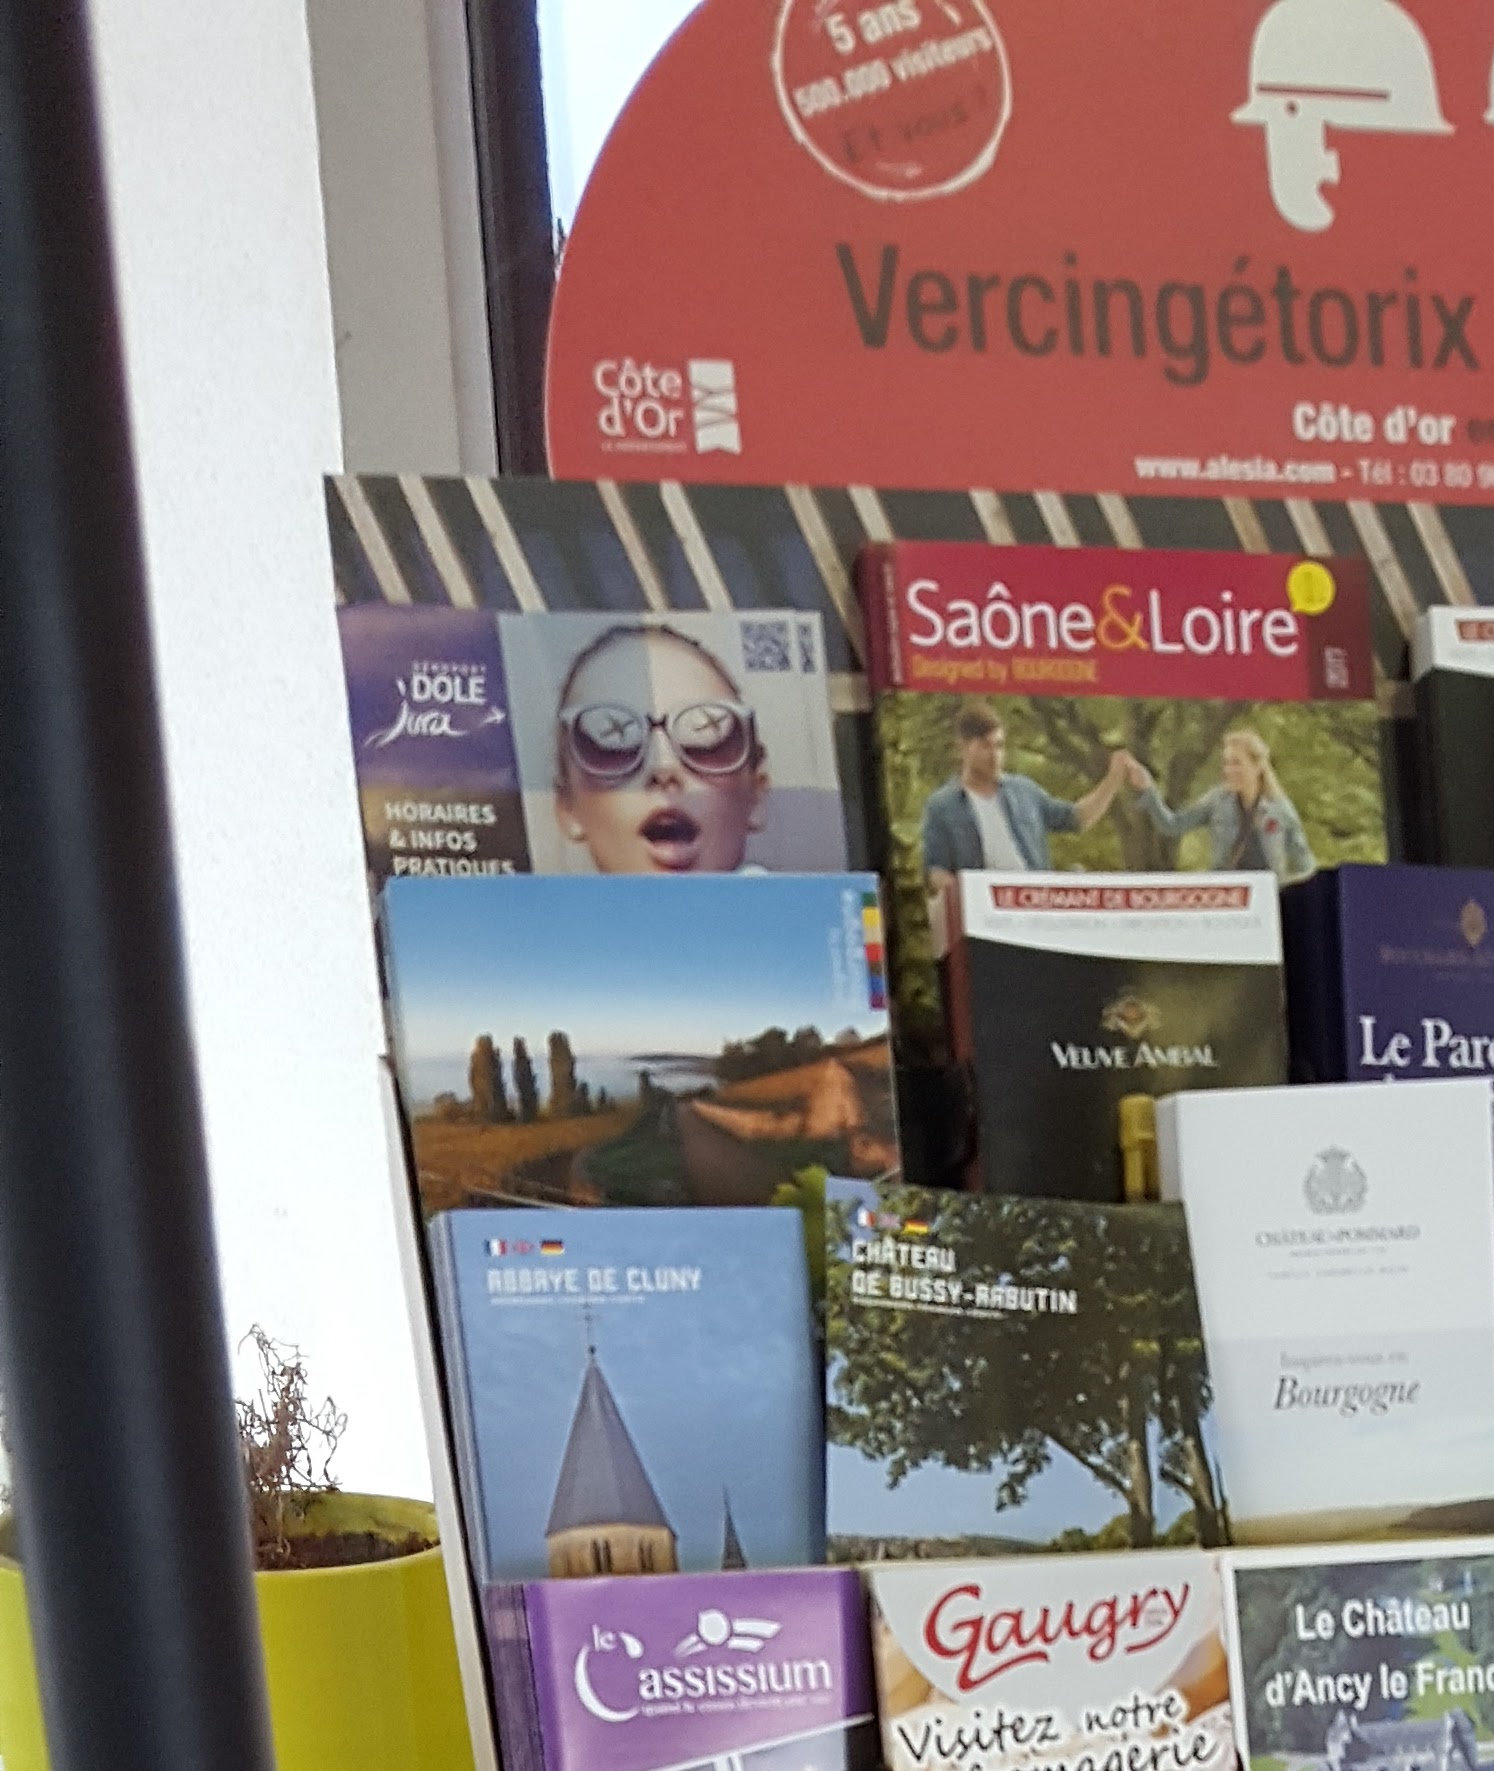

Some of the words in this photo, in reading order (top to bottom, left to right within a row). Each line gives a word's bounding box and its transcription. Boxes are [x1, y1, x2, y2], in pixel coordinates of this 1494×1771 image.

[825, 12, 855, 56] 5
[857, 0, 921, 45] ans
[836, 242, 1479, 387] Vercingétorix
[594, 356, 683, 399] Côte
[599, 397, 685, 438] d'Or
[1292, 400, 1374, 444] Côte
[1384, 405, 1456, 446] d'or
[1134, 455, 1336, 486] www.alesia.com
[411, 676, 486, 704] DOLE
[386, 801, 496, 826] HORAIRES
[411, 831, 477, 852] INFOS
[1050, 1041, 1130, 1070] VEUVE
[1134, 1042, 1219, 1070] AMBAL
[1359, 1015, 1412, 1066] Le
[852, 1235, 957, 1273] CHÂTEAU
[487, 1267, 579, 1294] ABBAYE
[587, 1267, 619, 1293] DE
[626, 1266, 702, 1292] CLUNY
[852, 1268, 881, 1297] DE
[888, 1273, 1079, 1314] BUSSY-RABUTIN
[1273, 1374, 1421, 1418] Bourgogne
[923, 1580, 1191, 1692] Gaugry
[1295, 1603, 1335, 1640] Le
[1342, 1597, 1471, 1638] Château
[1265, 1669, 1373, 1710] d'Ancy
[1380, 1663, 1409, 1699] le
[896, 1710, 1061, 1763] Visitez
[1083, 1691, 1185, 1732] notre
